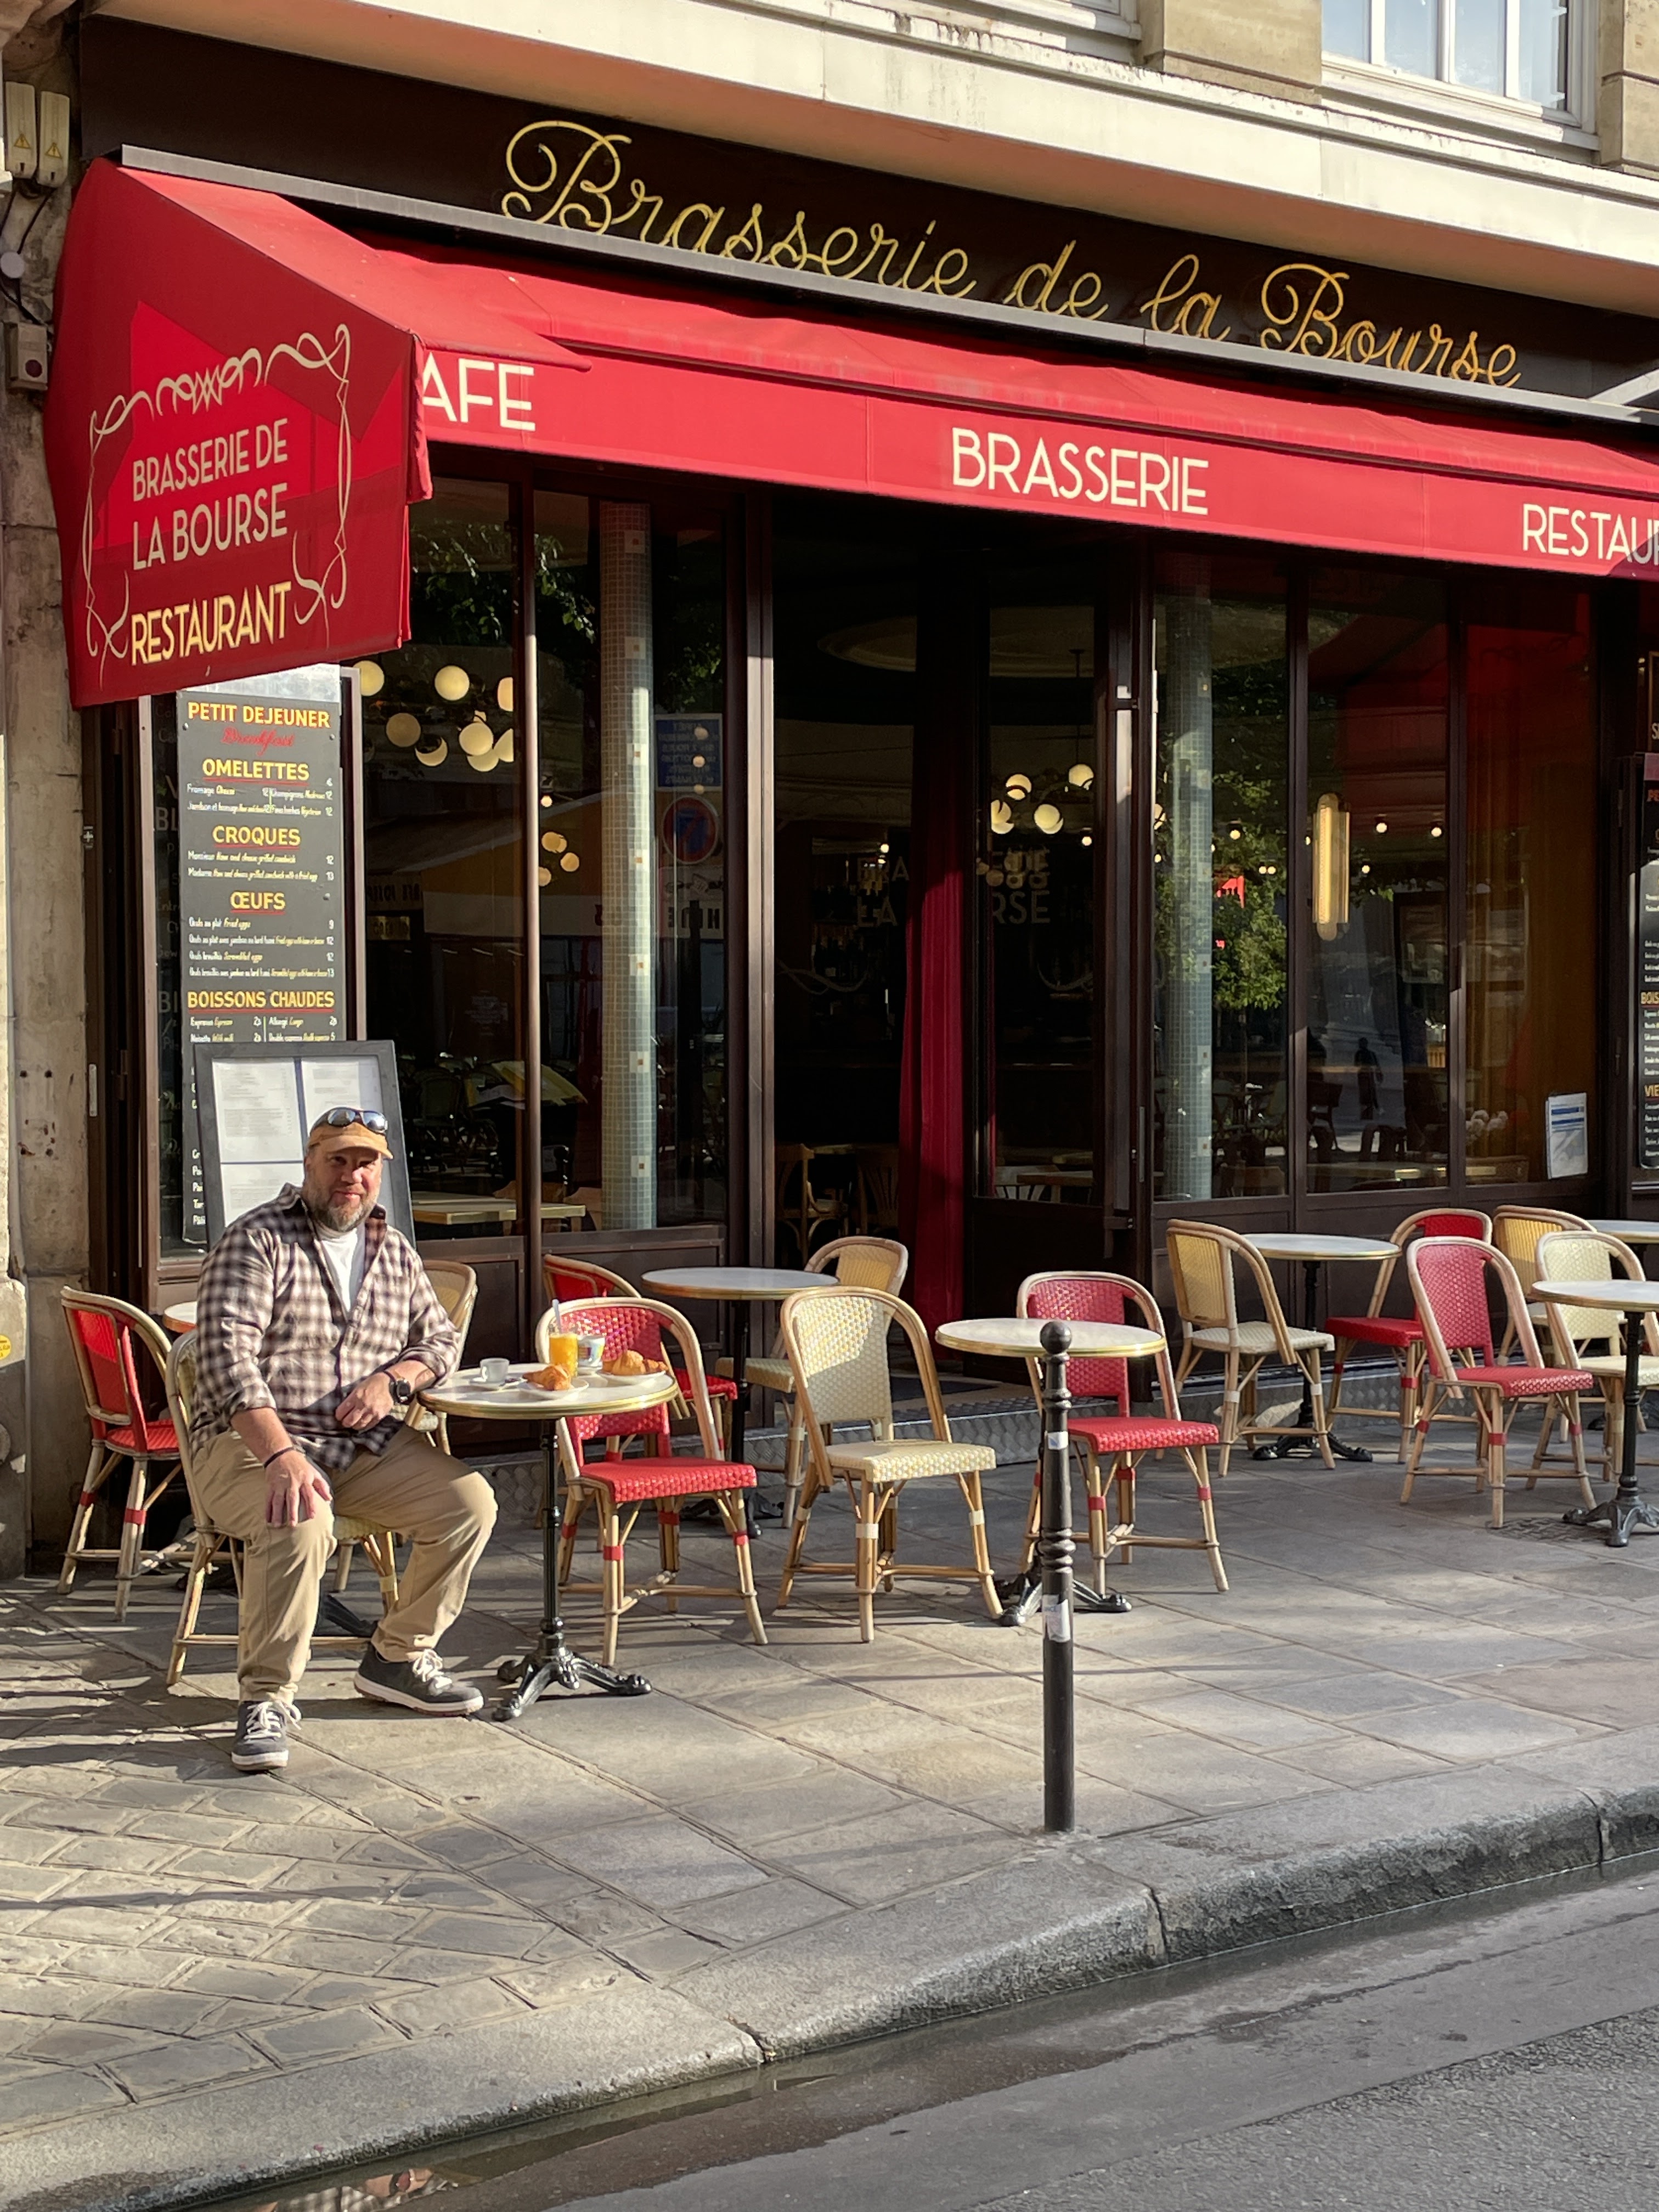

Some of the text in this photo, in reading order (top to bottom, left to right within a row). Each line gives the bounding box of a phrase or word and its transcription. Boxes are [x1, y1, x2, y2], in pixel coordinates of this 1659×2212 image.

[501, 121, 1521, 388] Brasserie de la Bourse
[422, 352, 535, 431] AFE
[133, 418, 287, 501] BRASSERIE DE
[952, 427, 1209, 515] BRASSERIE
[133, 483, 287, 571] LA BOURSE
[132, 582, 291, 666] RESTAURANT
[188, 702, 237, 722] PETIT
[242, 706, 331, 728] DEJEUNER
[202, 759, 309, 781] OMELETTES
[213, 826, 301, 846] CROQUES
[230, 891, 286, 910] ŒUFS
[991, 890, 1051, 925] RSE
[188, 991, 335, 1008] BOISSONS CHAUDES
